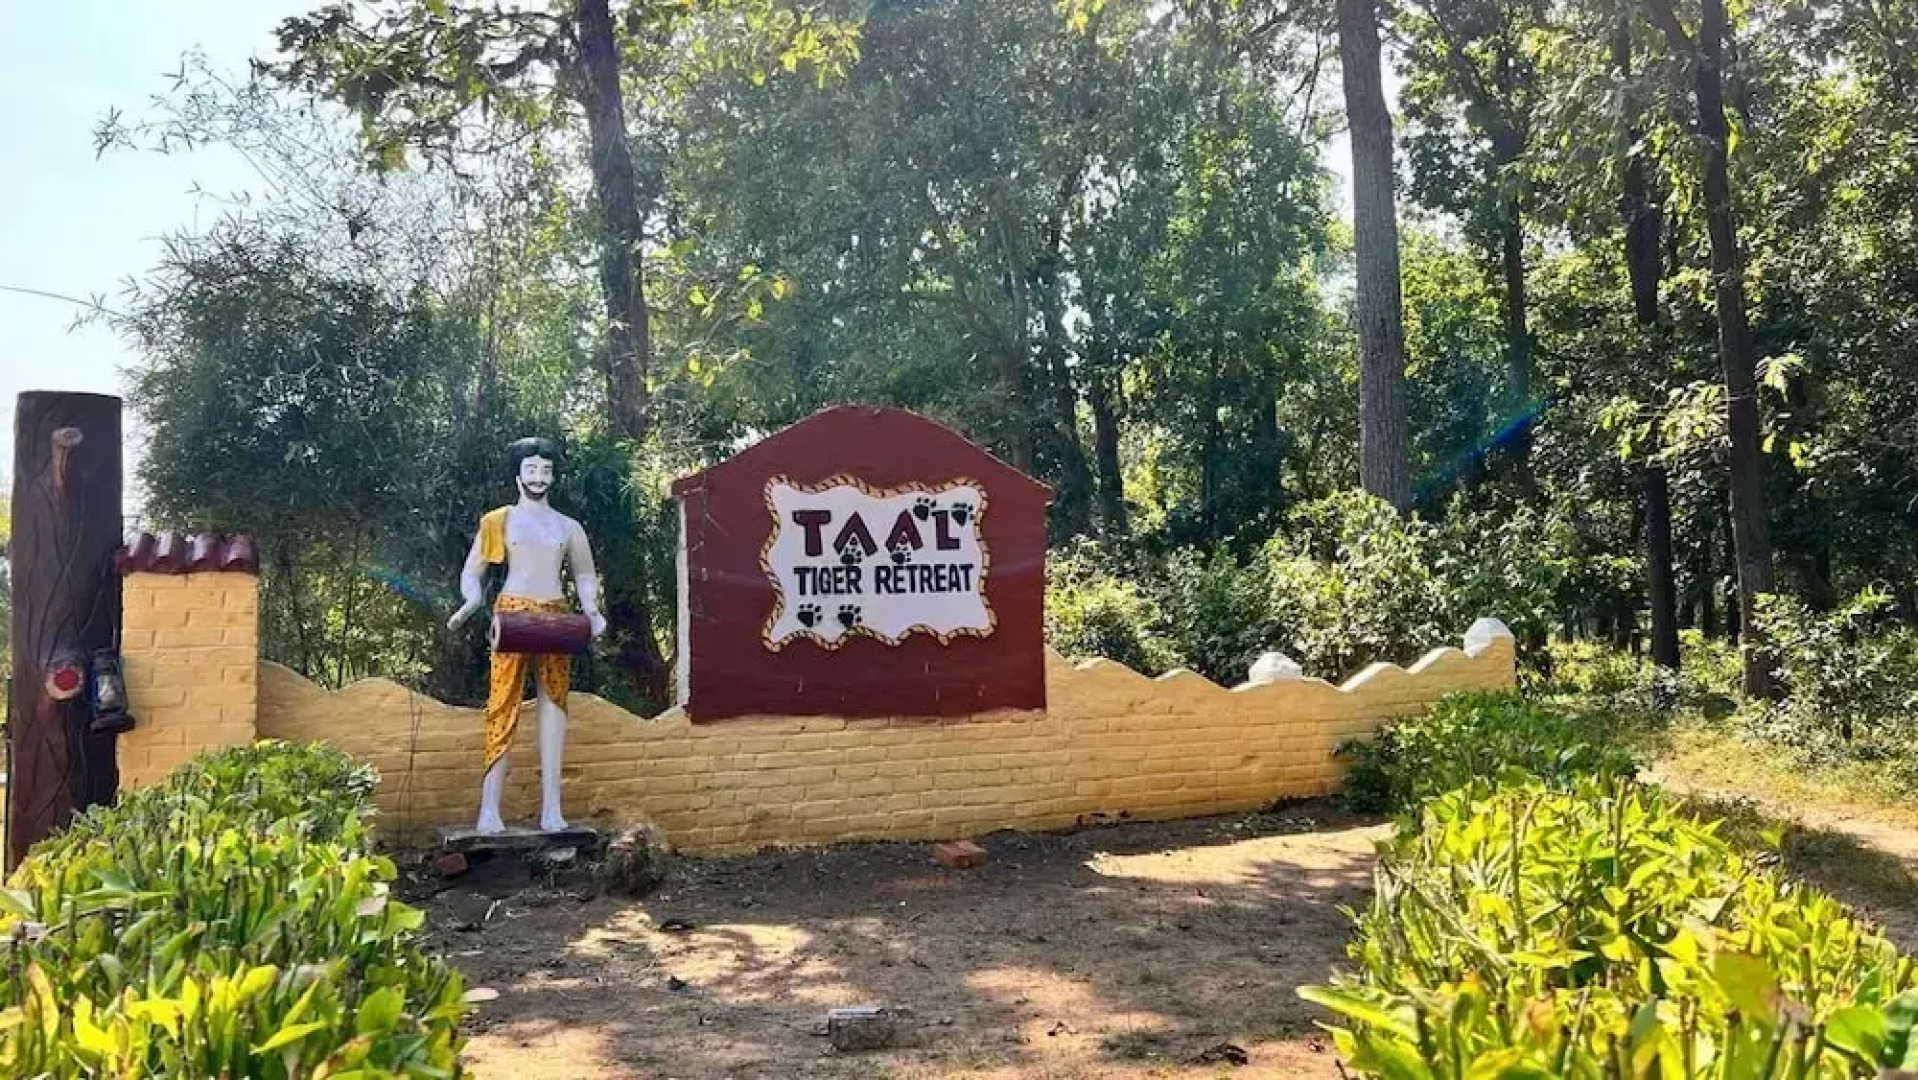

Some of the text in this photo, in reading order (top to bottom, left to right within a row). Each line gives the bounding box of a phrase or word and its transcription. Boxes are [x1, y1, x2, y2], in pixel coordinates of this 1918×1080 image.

[792, 509, 960, 557] TAAL
[793, 563, 974, 595] TIGER RETREAT
